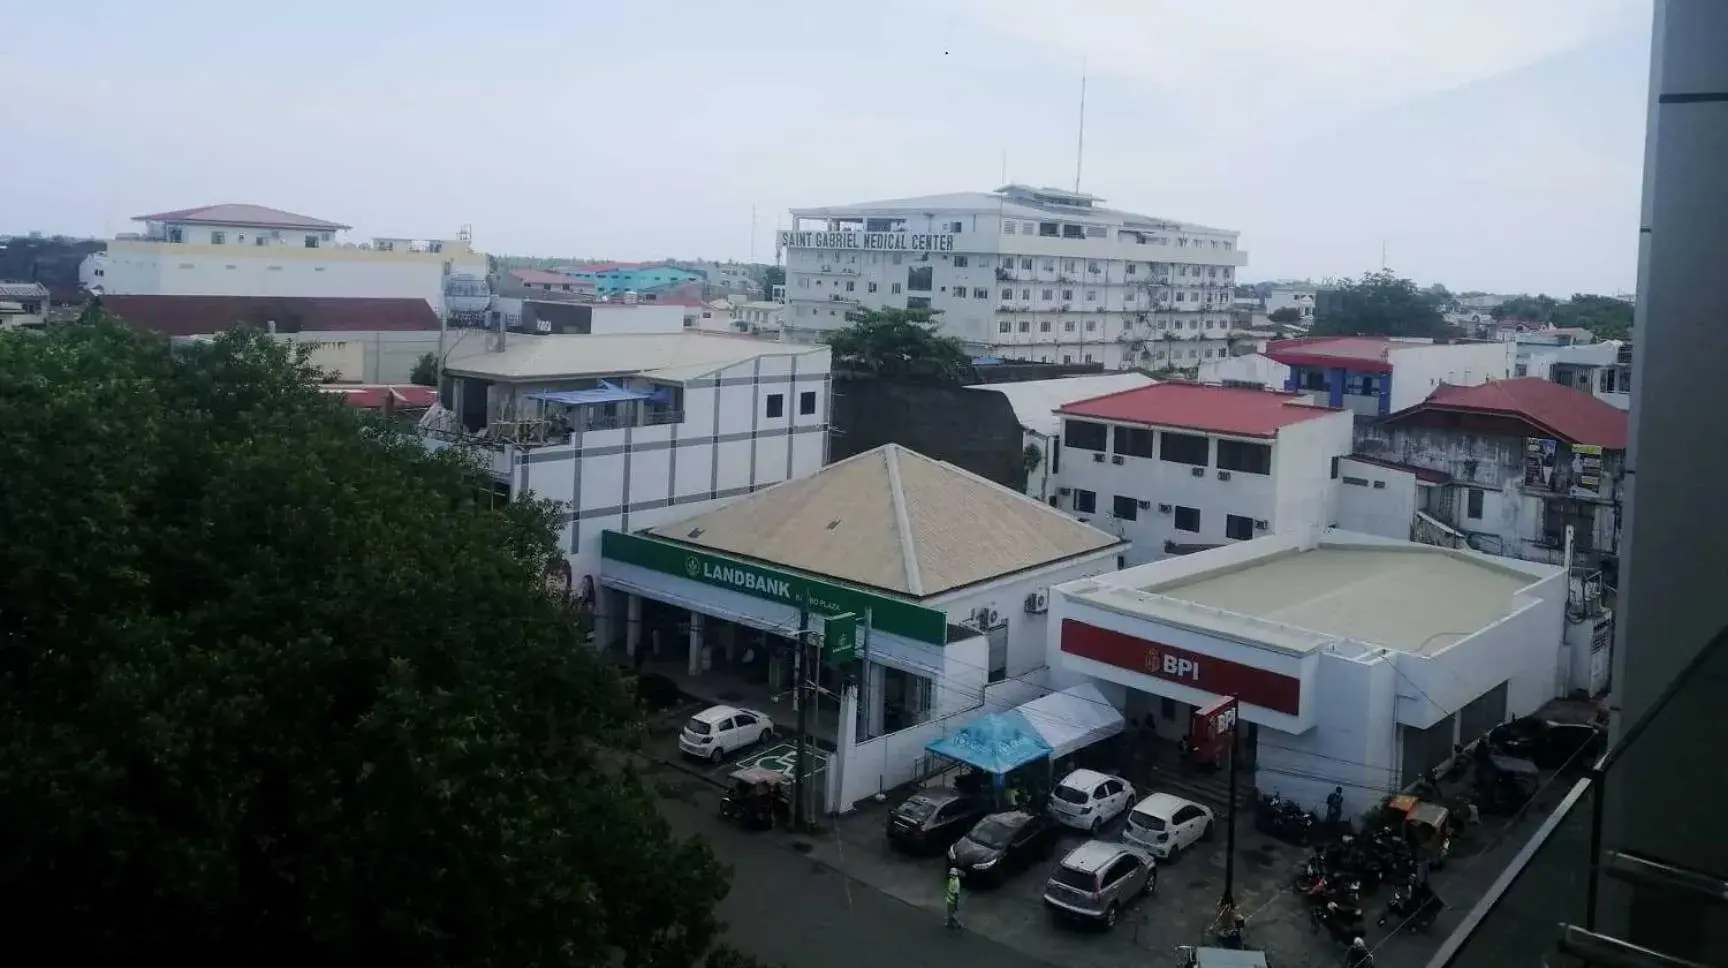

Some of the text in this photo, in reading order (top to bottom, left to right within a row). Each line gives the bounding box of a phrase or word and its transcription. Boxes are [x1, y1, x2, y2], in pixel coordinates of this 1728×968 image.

[782, 232, 953, 251] SAINT GABRIEL MEDICAL CENTER
[703, 562, 790, 599] LANDBANK
[1163, 654, 1199, 681] BPI
[1217, 707, 1236, 734] BPI
